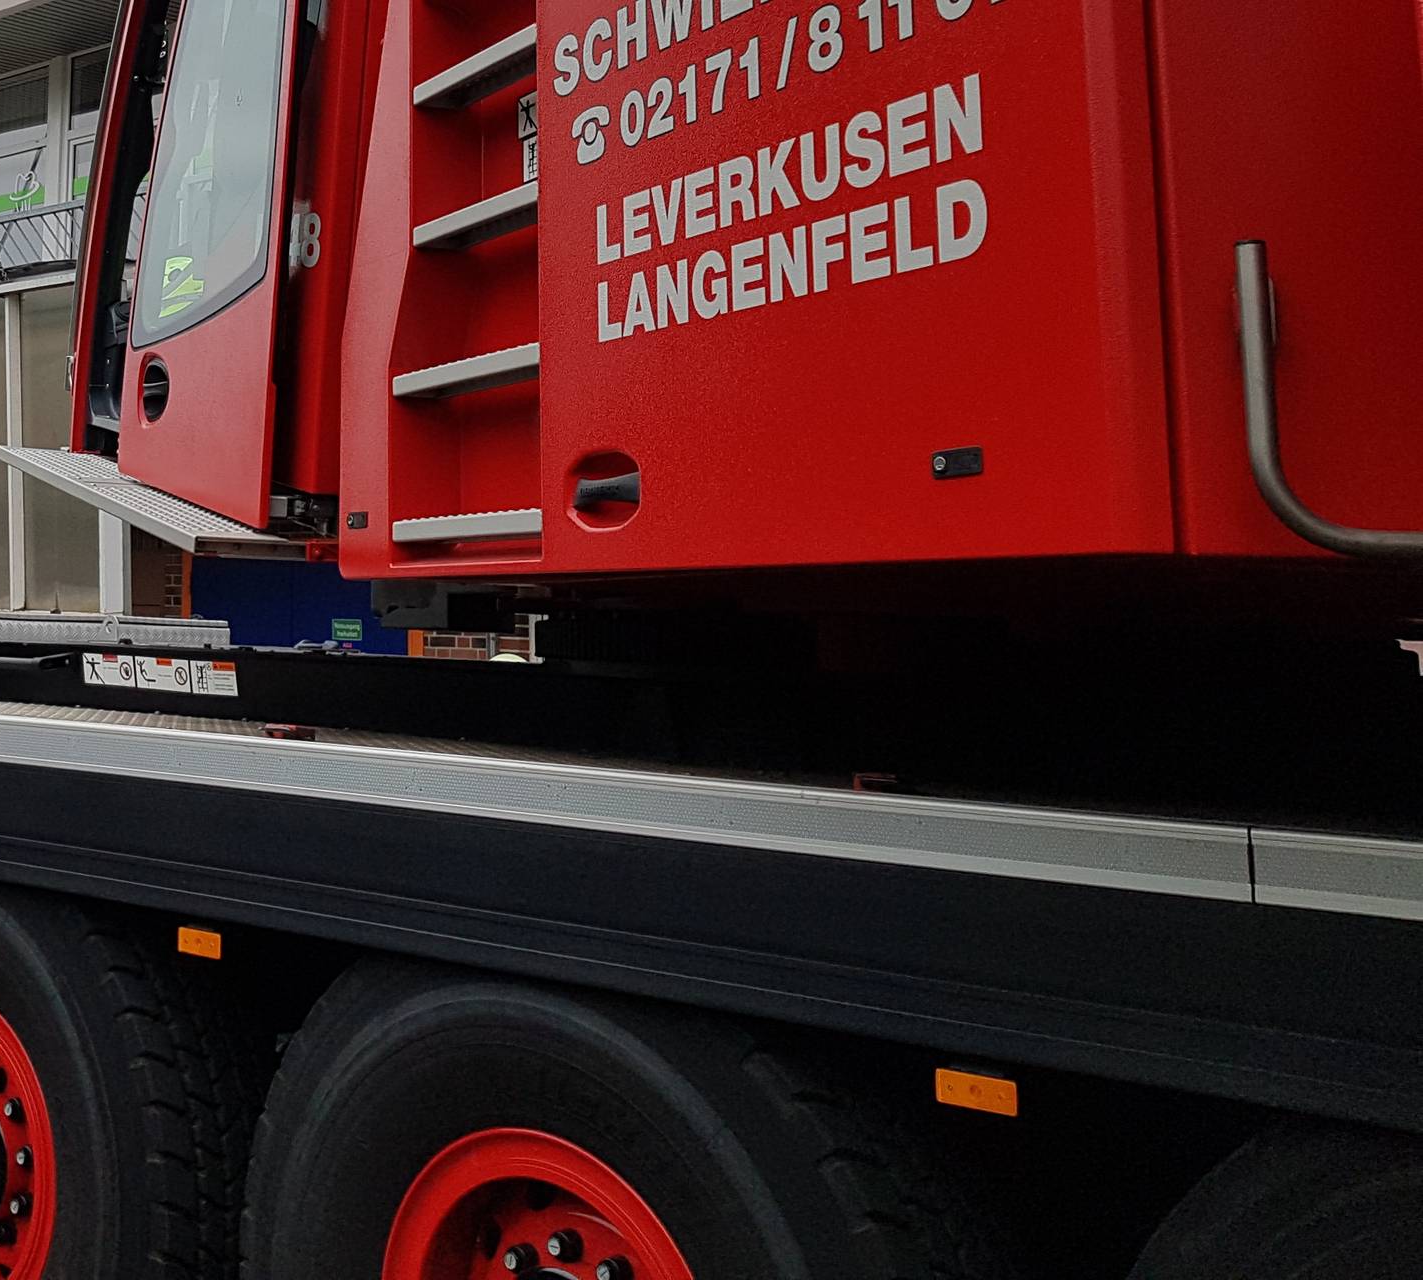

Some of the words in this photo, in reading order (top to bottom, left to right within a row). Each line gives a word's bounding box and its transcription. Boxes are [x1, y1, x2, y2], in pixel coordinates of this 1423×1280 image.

[553, 0, 770, 97] SCHWI
[596, 73, 983, 264] LEVERKUSEN
[598, 179, 988, 342] LANGENFELD
